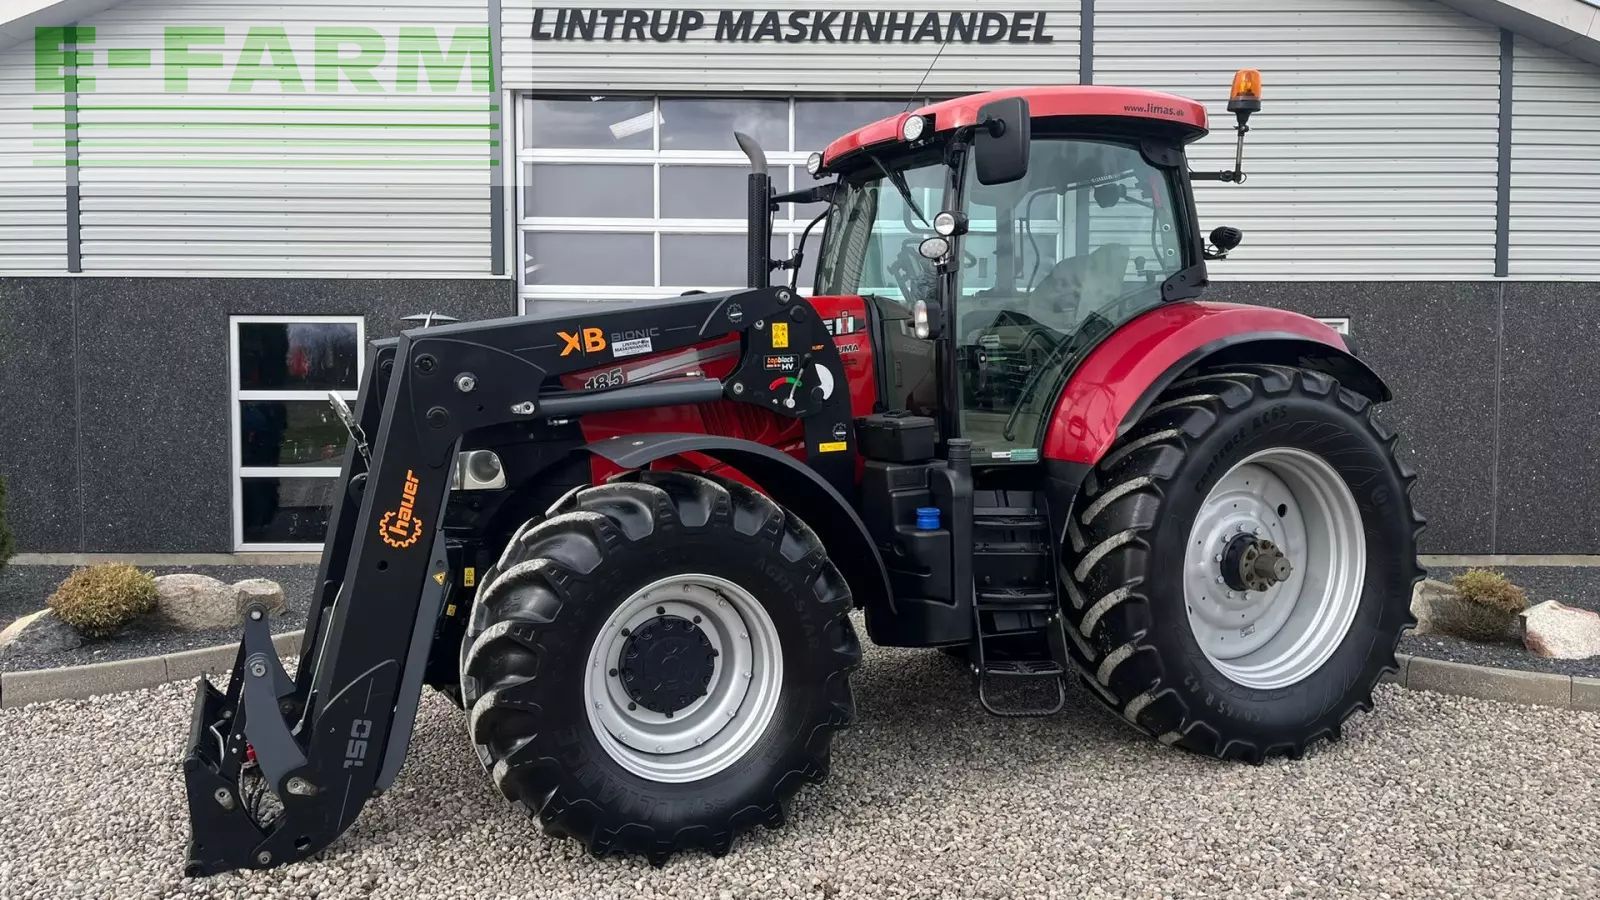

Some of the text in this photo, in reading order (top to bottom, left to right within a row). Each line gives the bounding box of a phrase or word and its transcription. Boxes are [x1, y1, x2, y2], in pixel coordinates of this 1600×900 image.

[531, 8, 1054, 44] LINTRUP MASKINHANDEL
[1123, 103, 1184, 116] www.limas.dk
[611, 327, 660, 342] BIONIC
[836, 343, 859, 354] UMA
[584, 367, 624, 389] 185
[388, 469, 419, 537] hauer
[343, 718, 372, 769] 150
